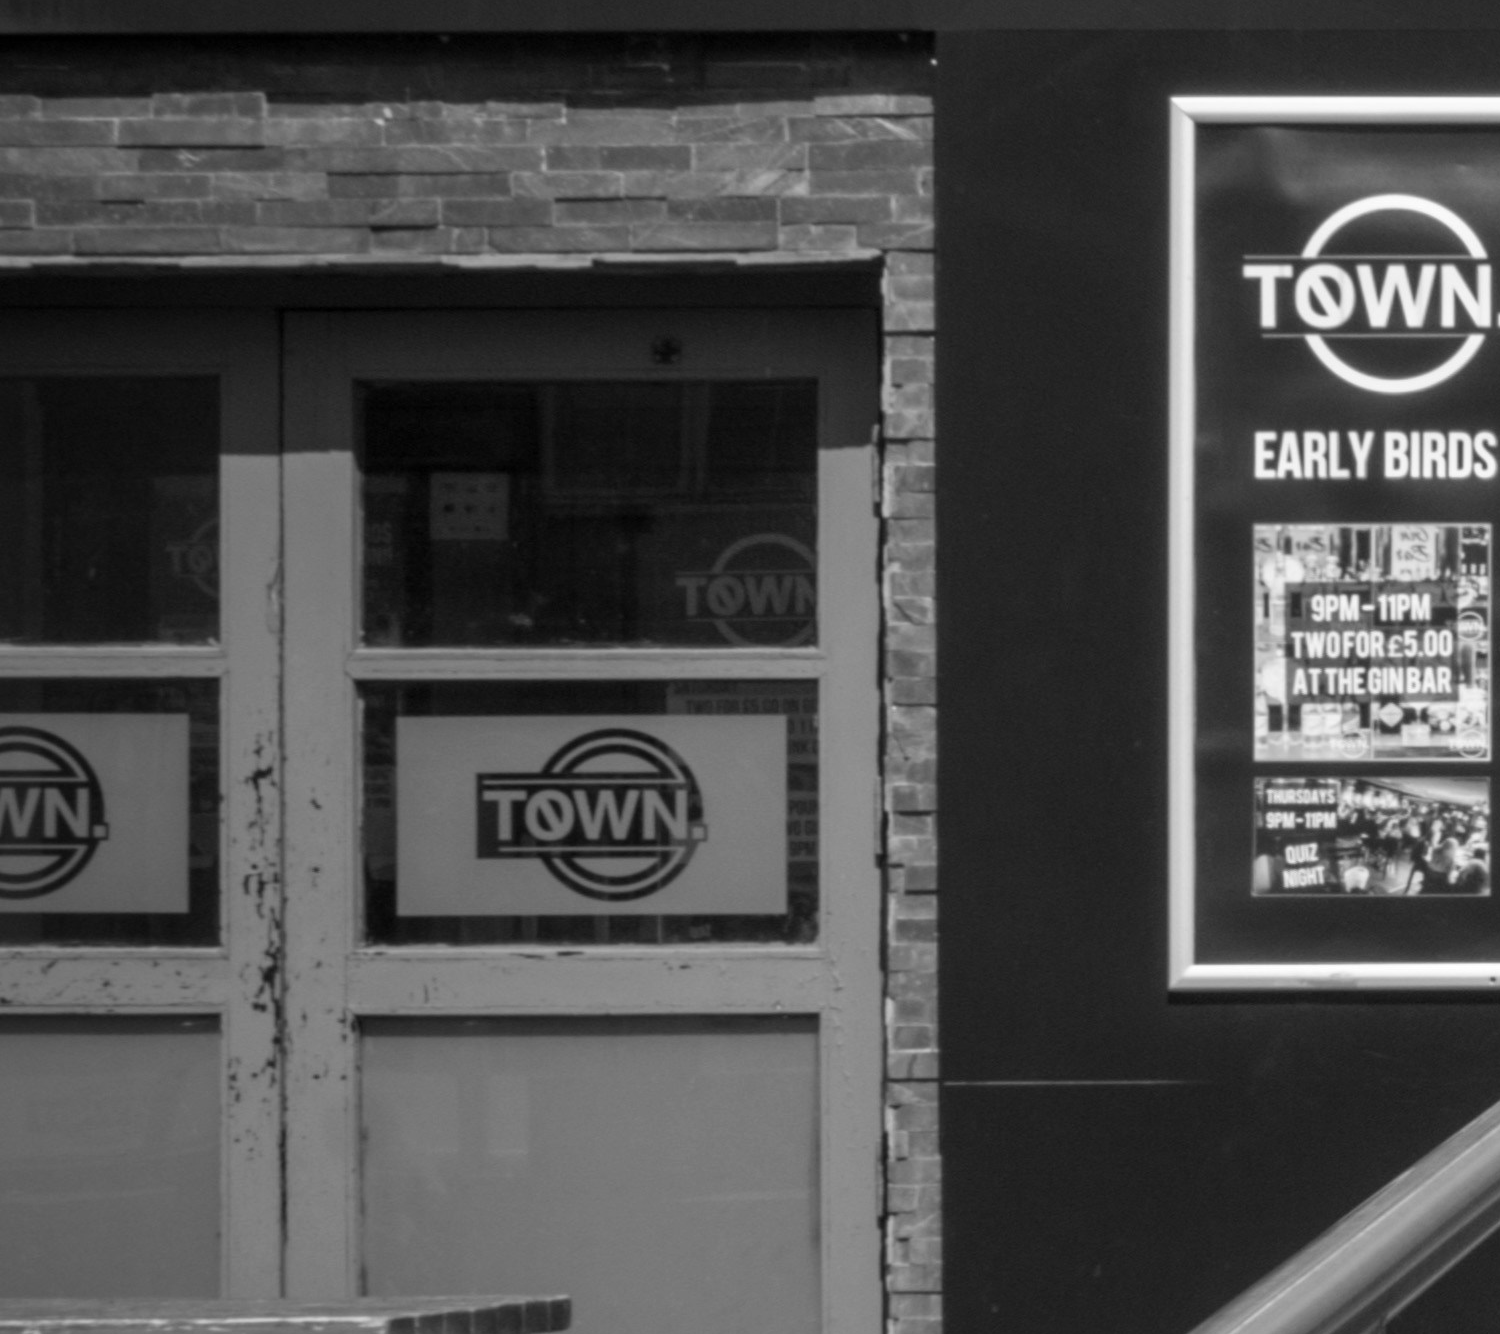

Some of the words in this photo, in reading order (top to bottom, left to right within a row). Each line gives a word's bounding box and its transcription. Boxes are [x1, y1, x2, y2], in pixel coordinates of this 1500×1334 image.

[1254, 431, 1374, 480] EARLY
[1384, 431, 1498, 480] BIRDS
[1291, 632, 1341, 659] TWO
[1343, 631, 1385, 659] FOR
[1388, 630, 1453, 659] £5.00
[1293, 668, 1322, 695] AT
[1325, 668, 1366, 695] THE
[1368, 667, 1403, 695] GIN
[1406, 667, 1453, 695] BAR
[1266, 788, 1336, 805] THURSDAYS
[0, 787, 106, 839] WN.
[482, 788, 705, 841] TOWN.
[1285, 843, 1319, 865] QUIZ
[1282, 866, 1325, 889] NIGHT
